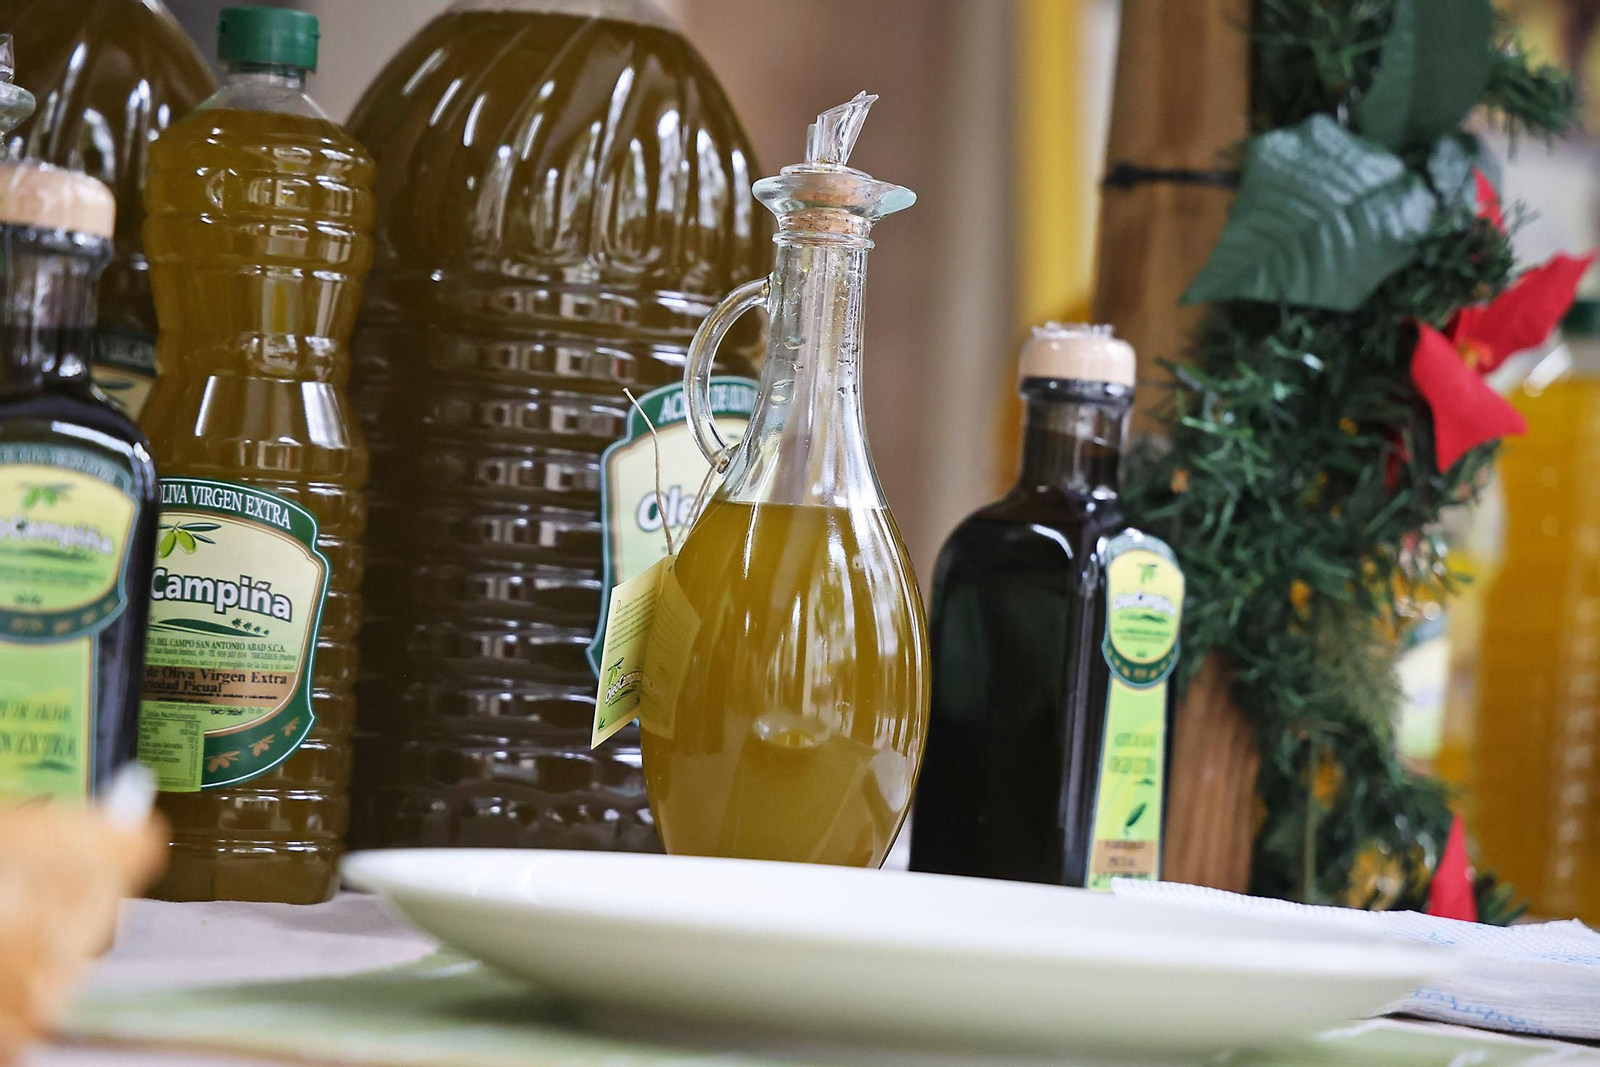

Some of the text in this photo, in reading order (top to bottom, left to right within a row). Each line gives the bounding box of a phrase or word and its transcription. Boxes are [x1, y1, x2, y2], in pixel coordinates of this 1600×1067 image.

[191, 485, 243, 512] VIRGEN
[245, 494, 291, 529] EXTRA
[635, 484, 710, 533] Ole
[151, 567, 292, 622] Campiña
[157, 638, 168, 646] DEL
[170, 638, 195, 648] CAMPO
[196, 640, 210, 649] SAN
[211, 641, 246, 651] ANTONIO
[247, 643, 267, 651] ABAD
[162, 666, 195, 680] Oliva
[200, 668, 246, 685] Virgen
[251, 671, 287, 685] Extra
[184, 681, 222, 693] Picual
